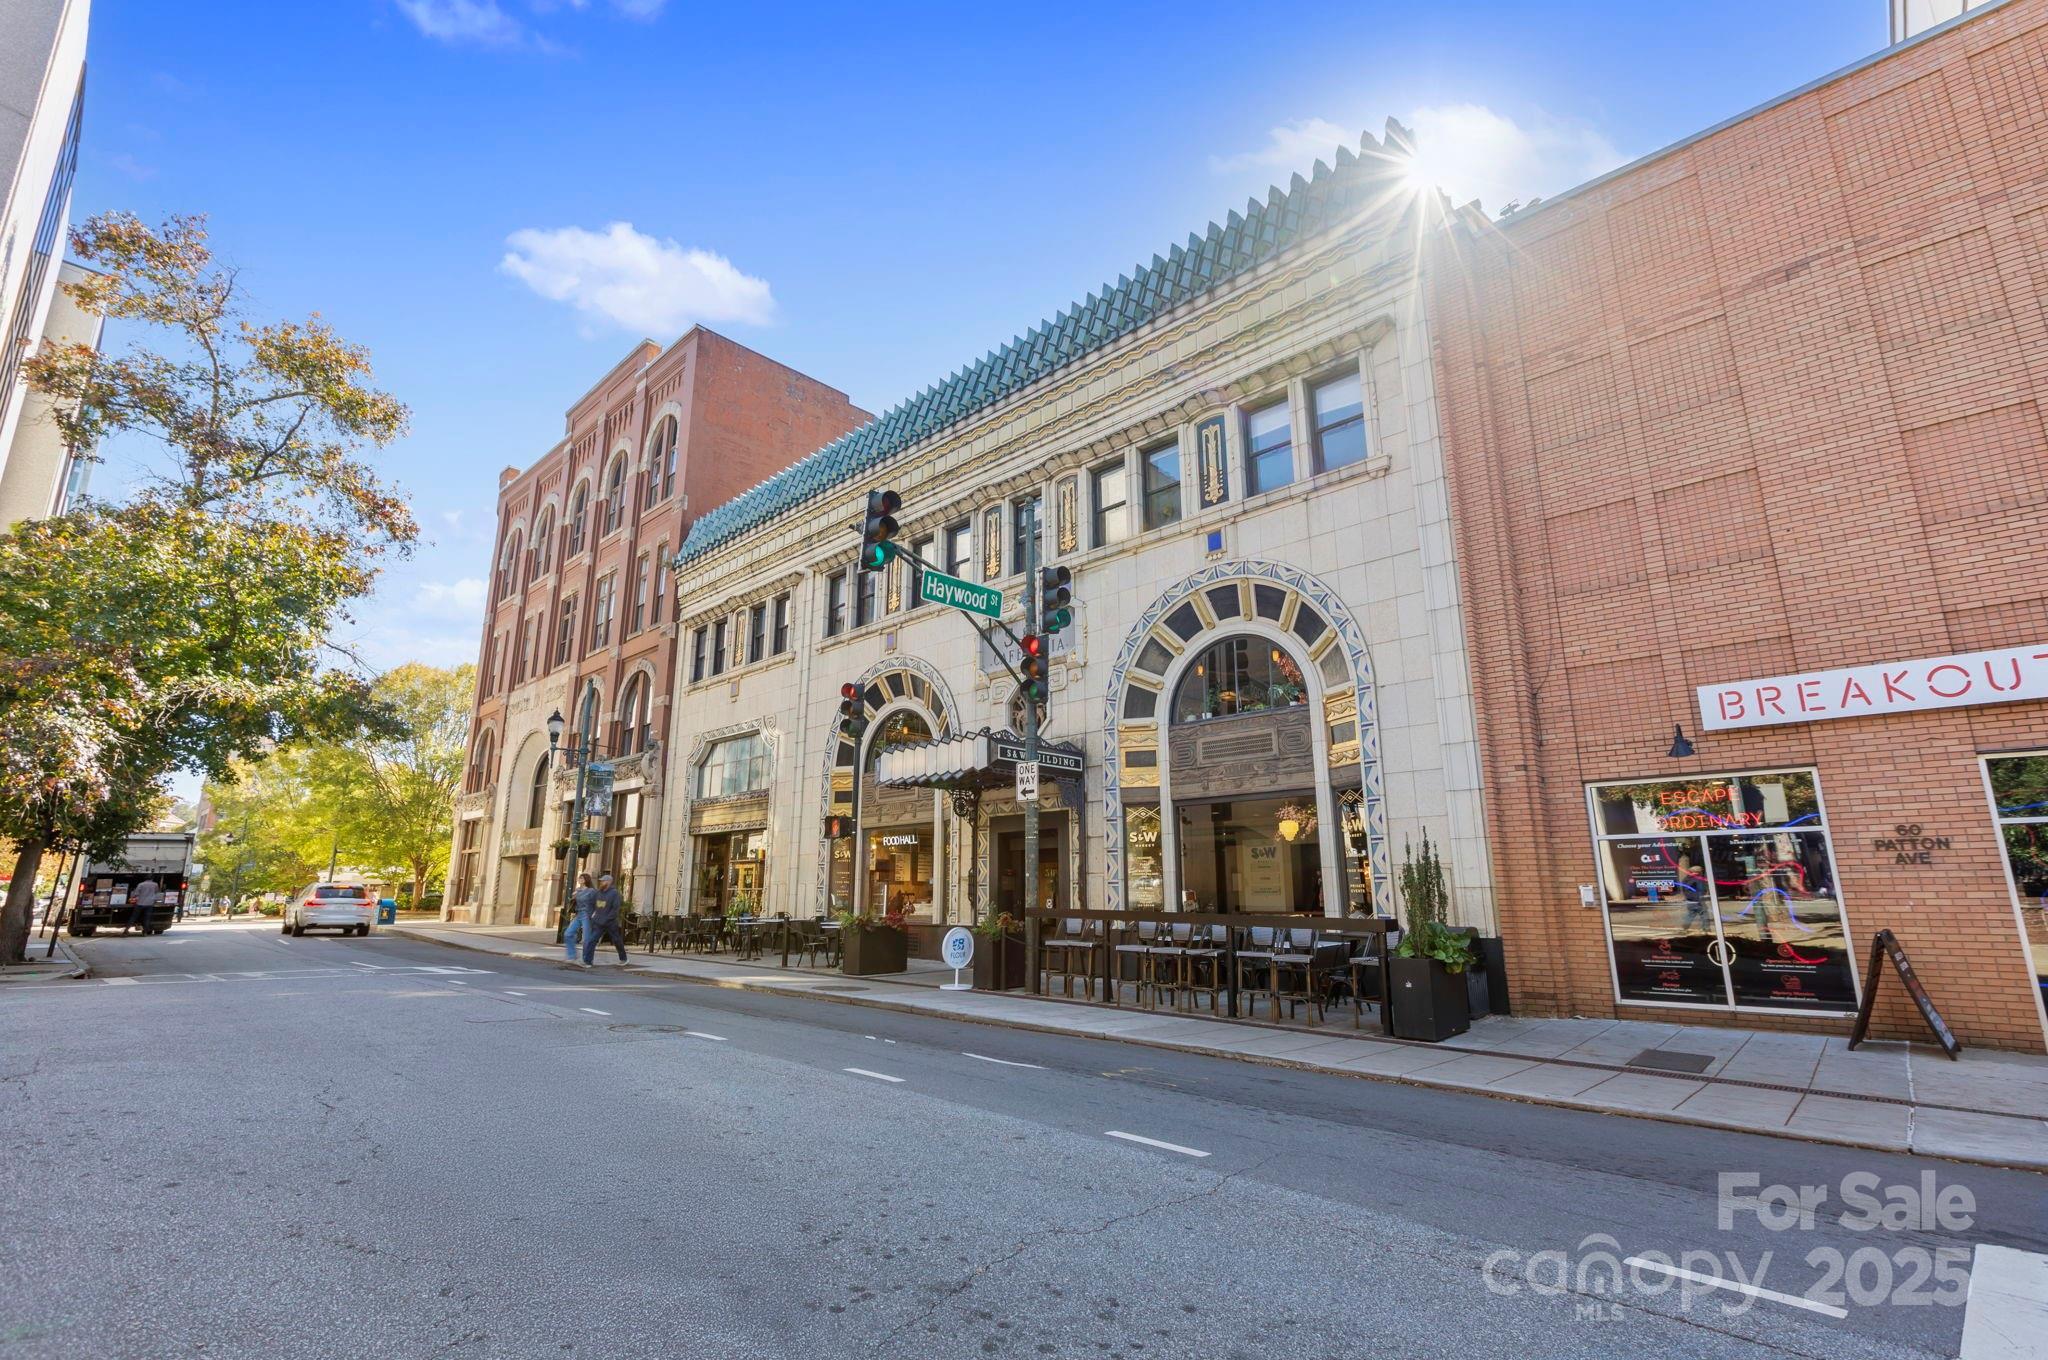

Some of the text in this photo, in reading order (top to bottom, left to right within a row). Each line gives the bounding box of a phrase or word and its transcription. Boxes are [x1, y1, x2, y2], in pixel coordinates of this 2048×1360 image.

[926, 575, 999, 610] Haywood St
[1019, 763, 1036, 775] ONE
[1019, 774, 1037, 786] WAY
[1660, 787, 1740, 805] ESCAPE
[1655, 811, 1763, 831] ORDINARY
[1895, 824, 1922, 836] 60
[882, 834, 919, 846] FOOD HALL
[1129, 831, 1158, 843] S&W
[1874, 837, 1951, 852] PATTON
[1895, 852, 1932, 865] AVE
[1635, 880, 1675, 888] MONOPOLY
